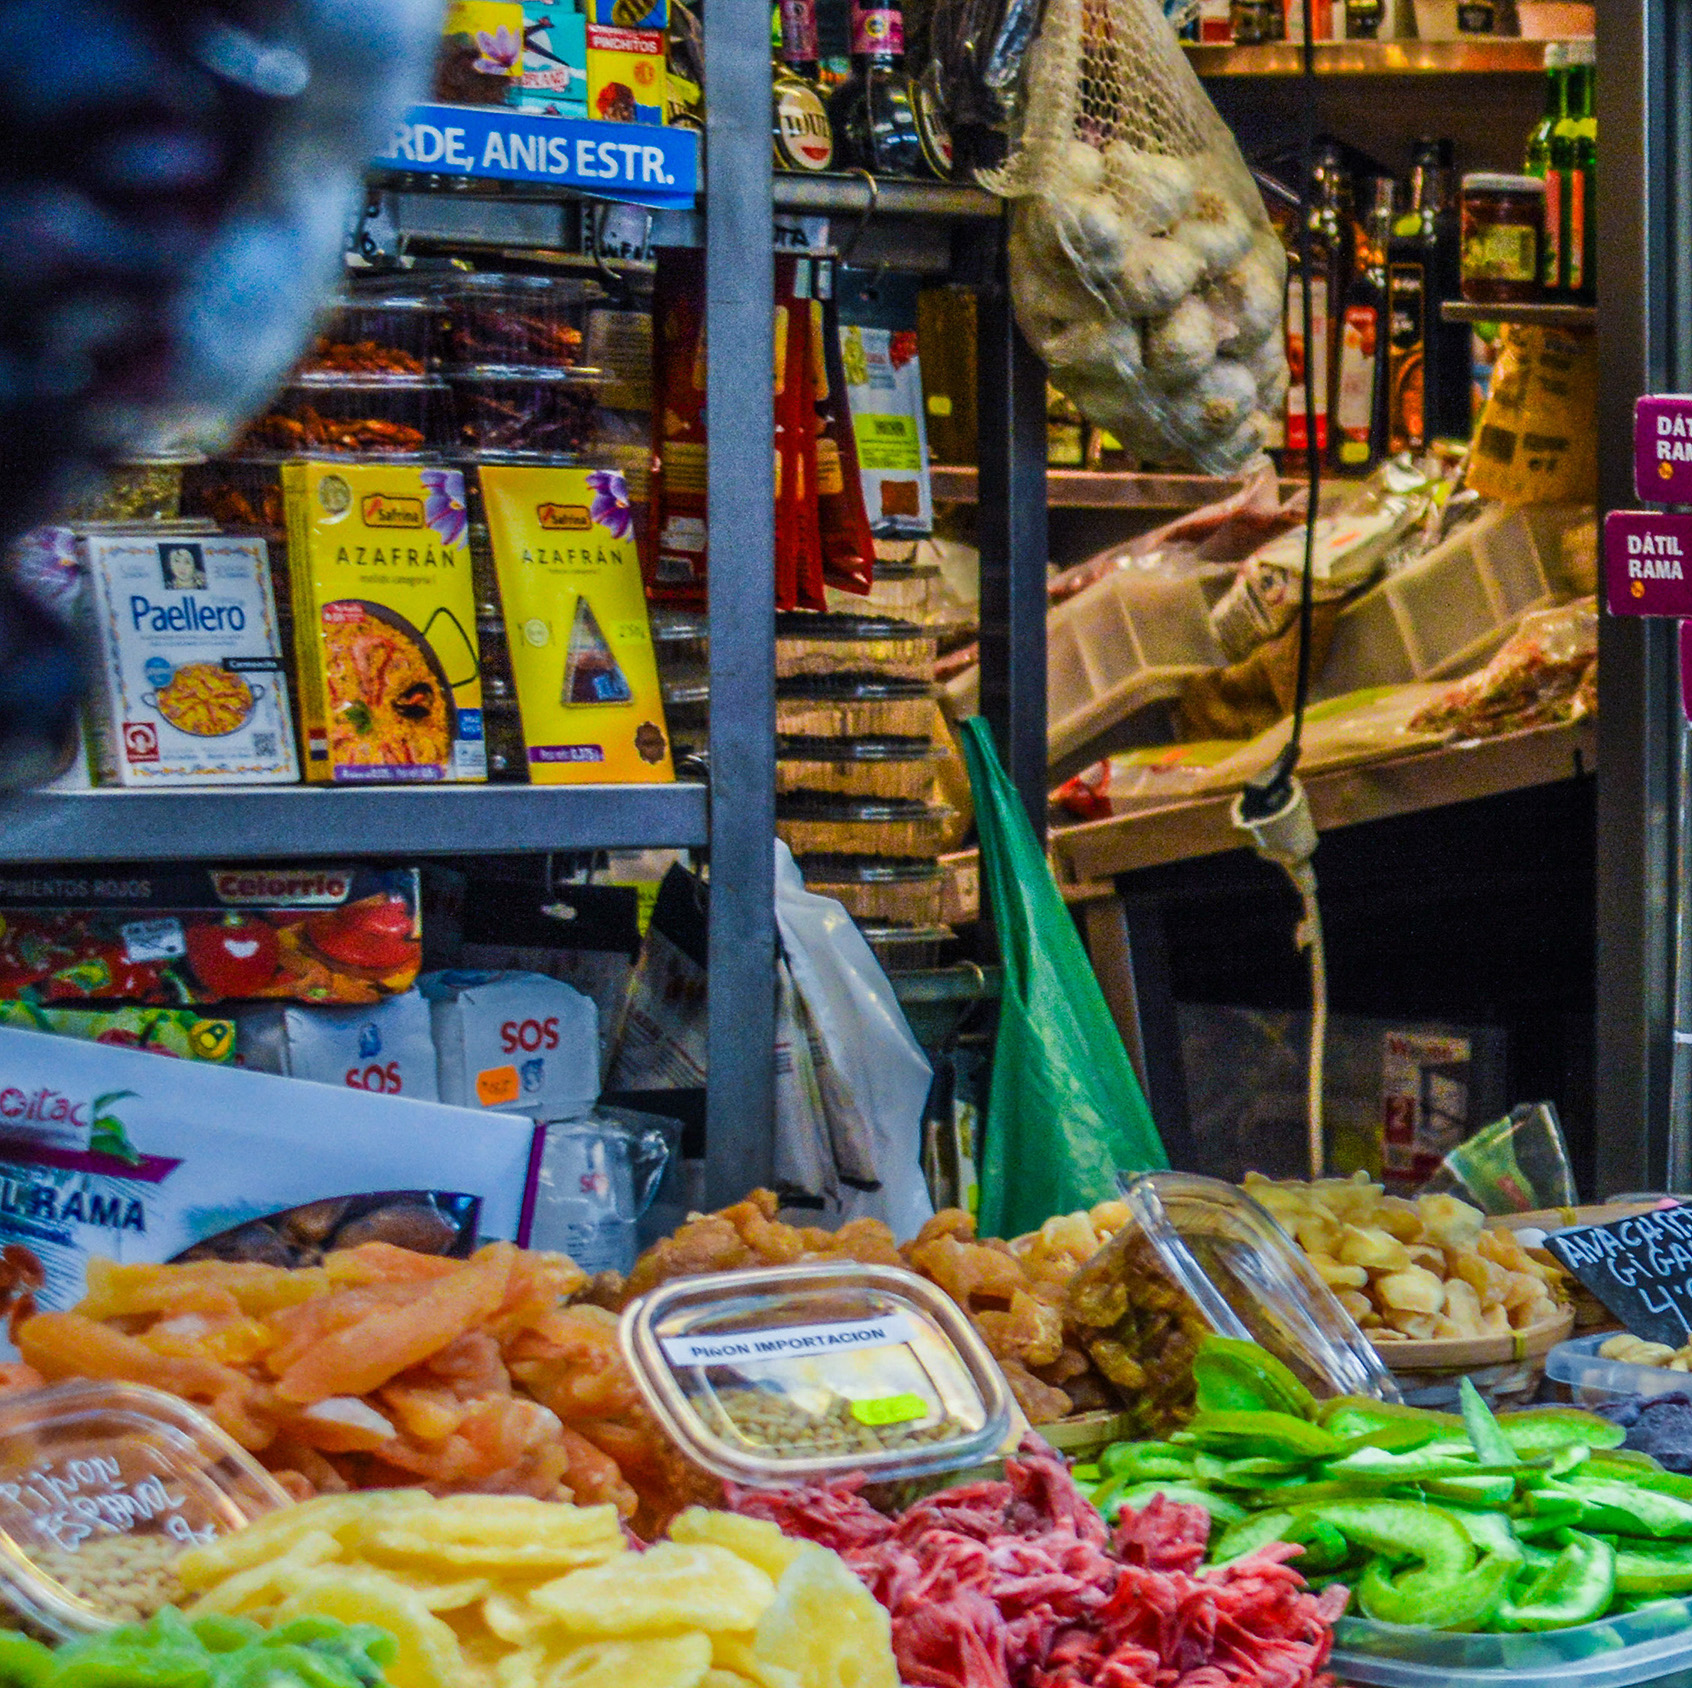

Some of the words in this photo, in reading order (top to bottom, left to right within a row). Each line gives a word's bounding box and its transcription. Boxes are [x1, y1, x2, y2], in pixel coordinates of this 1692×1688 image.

[482, 131, 569, 174] ANIS
[576, 139, 675, 185] ESTR.
[336, 544, 456, 568] AZAFRÁN
[522, 546, 623, 565] AZAFRÁN
[1627, 532, 1683, 557] DÁTIL
[1629, 559, 1684, 581] RAMA
[131, 594, 246, 632] Paellero
[500, 1017, 560, 1054] SOS
[345, 1061, 402, 1095] SOS
[30, 1185, 146, 1232] RAMA
[754, 1328, 887, 1353] IMPORTACION
